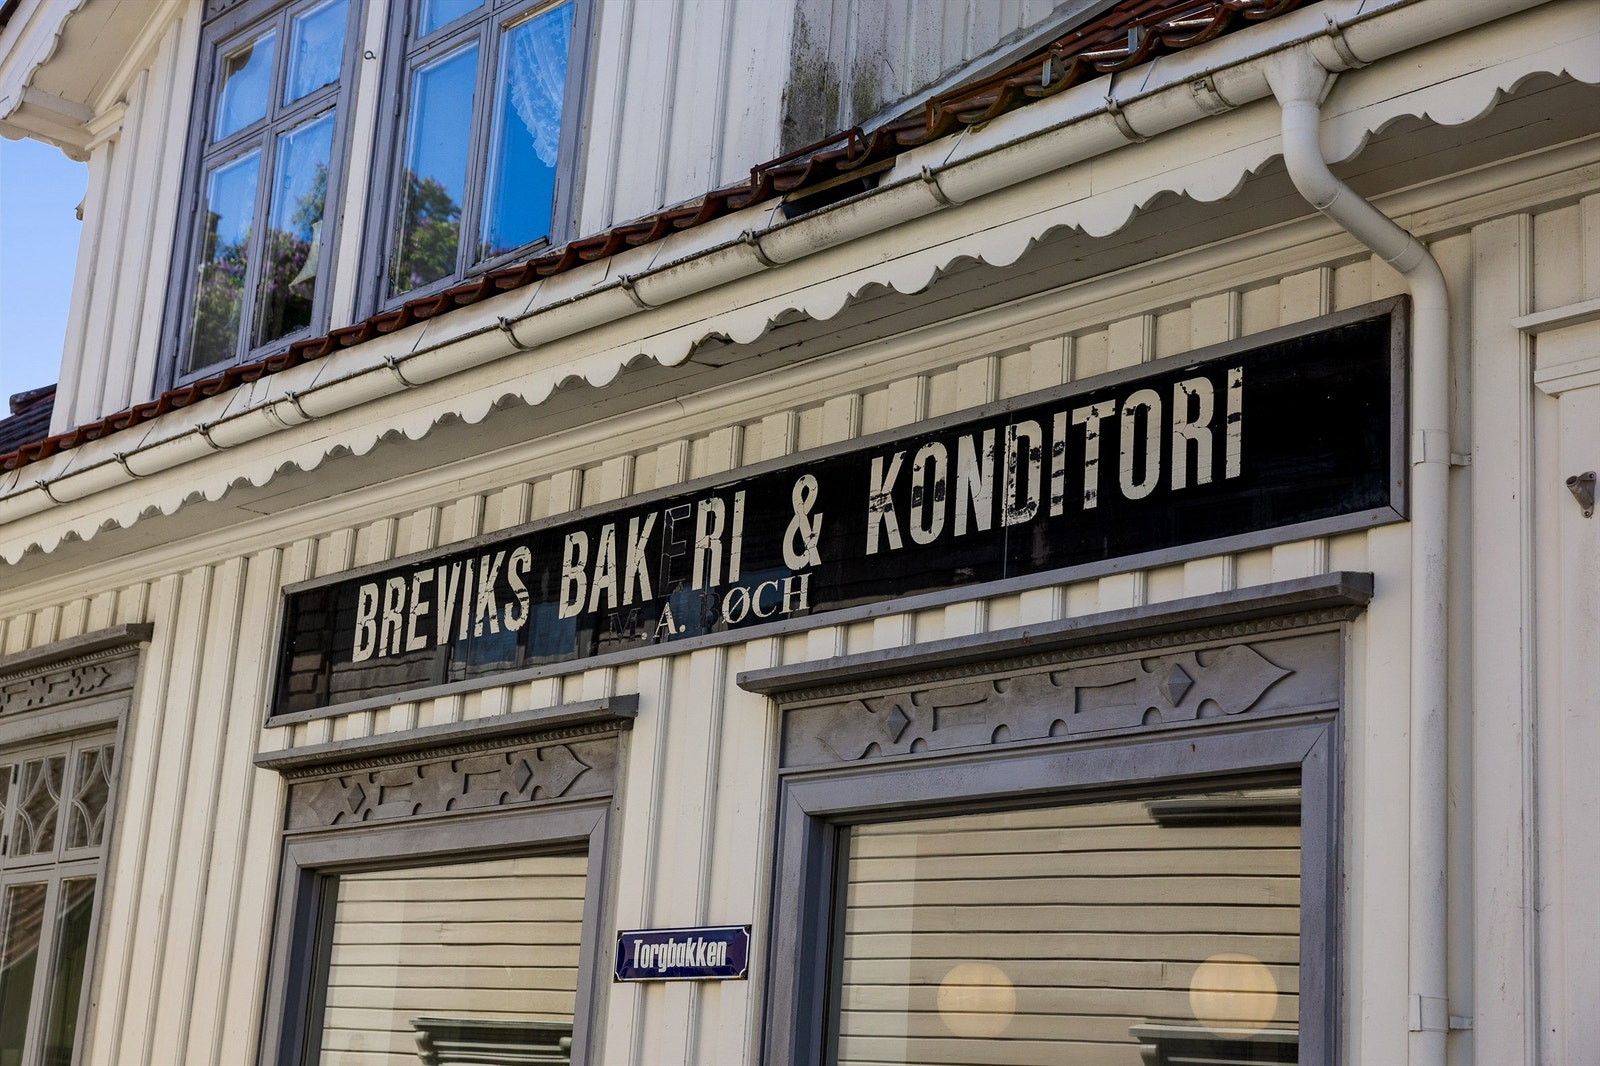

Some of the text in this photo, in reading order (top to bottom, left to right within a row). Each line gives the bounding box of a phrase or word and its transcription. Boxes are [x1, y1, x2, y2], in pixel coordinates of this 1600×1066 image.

[351, 366, 1243, 663] BREVIKS BAKERI & KONDITORI
[653, 601, 687, 639] A.
[633, 936, 727, 973] Torgbakken
